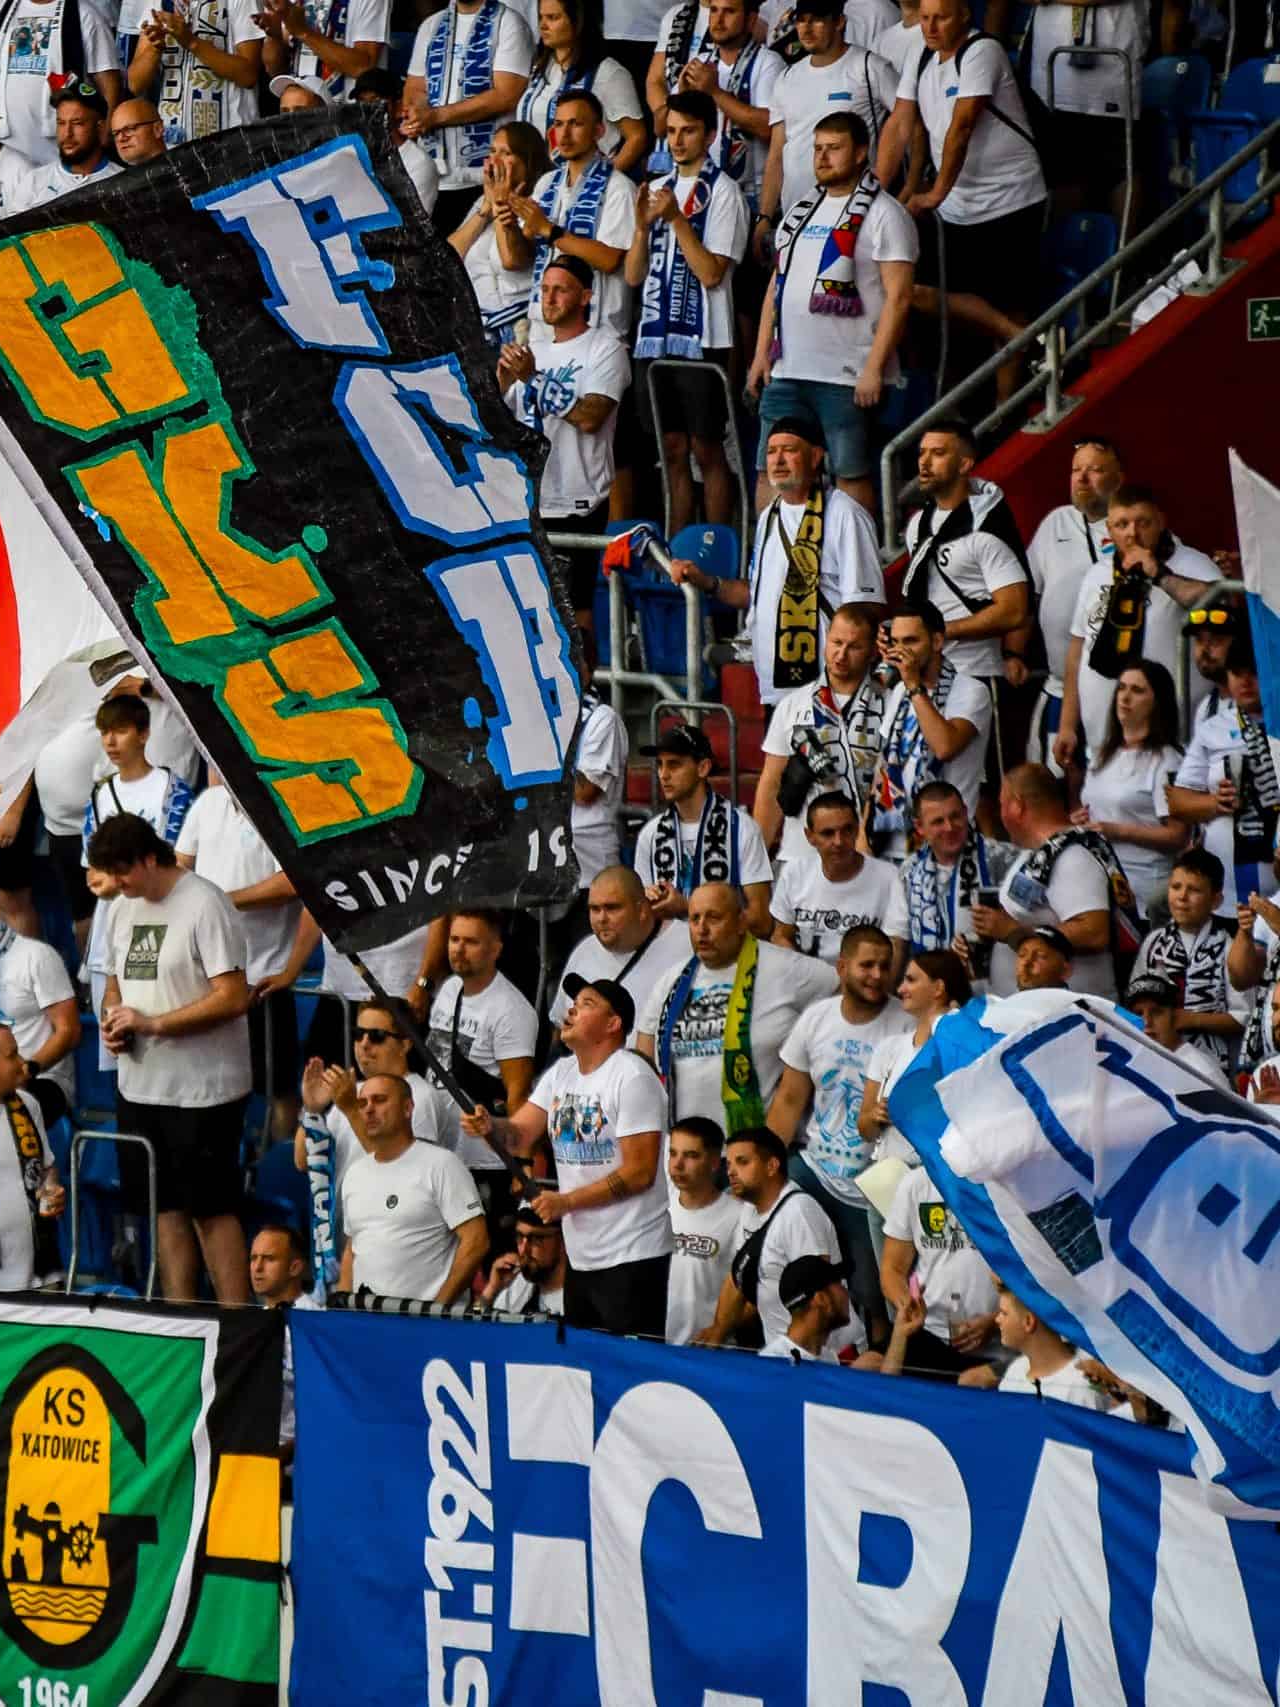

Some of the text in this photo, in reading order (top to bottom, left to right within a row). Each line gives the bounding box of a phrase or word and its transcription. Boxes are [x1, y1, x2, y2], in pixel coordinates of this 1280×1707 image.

[670, 260, 687, 323] FOOTBALL
[205, 143, 580, 777] FCB
[44, 1387, 86, 1428] KS
[21, 1432, 101, 1465] KATOWICE
